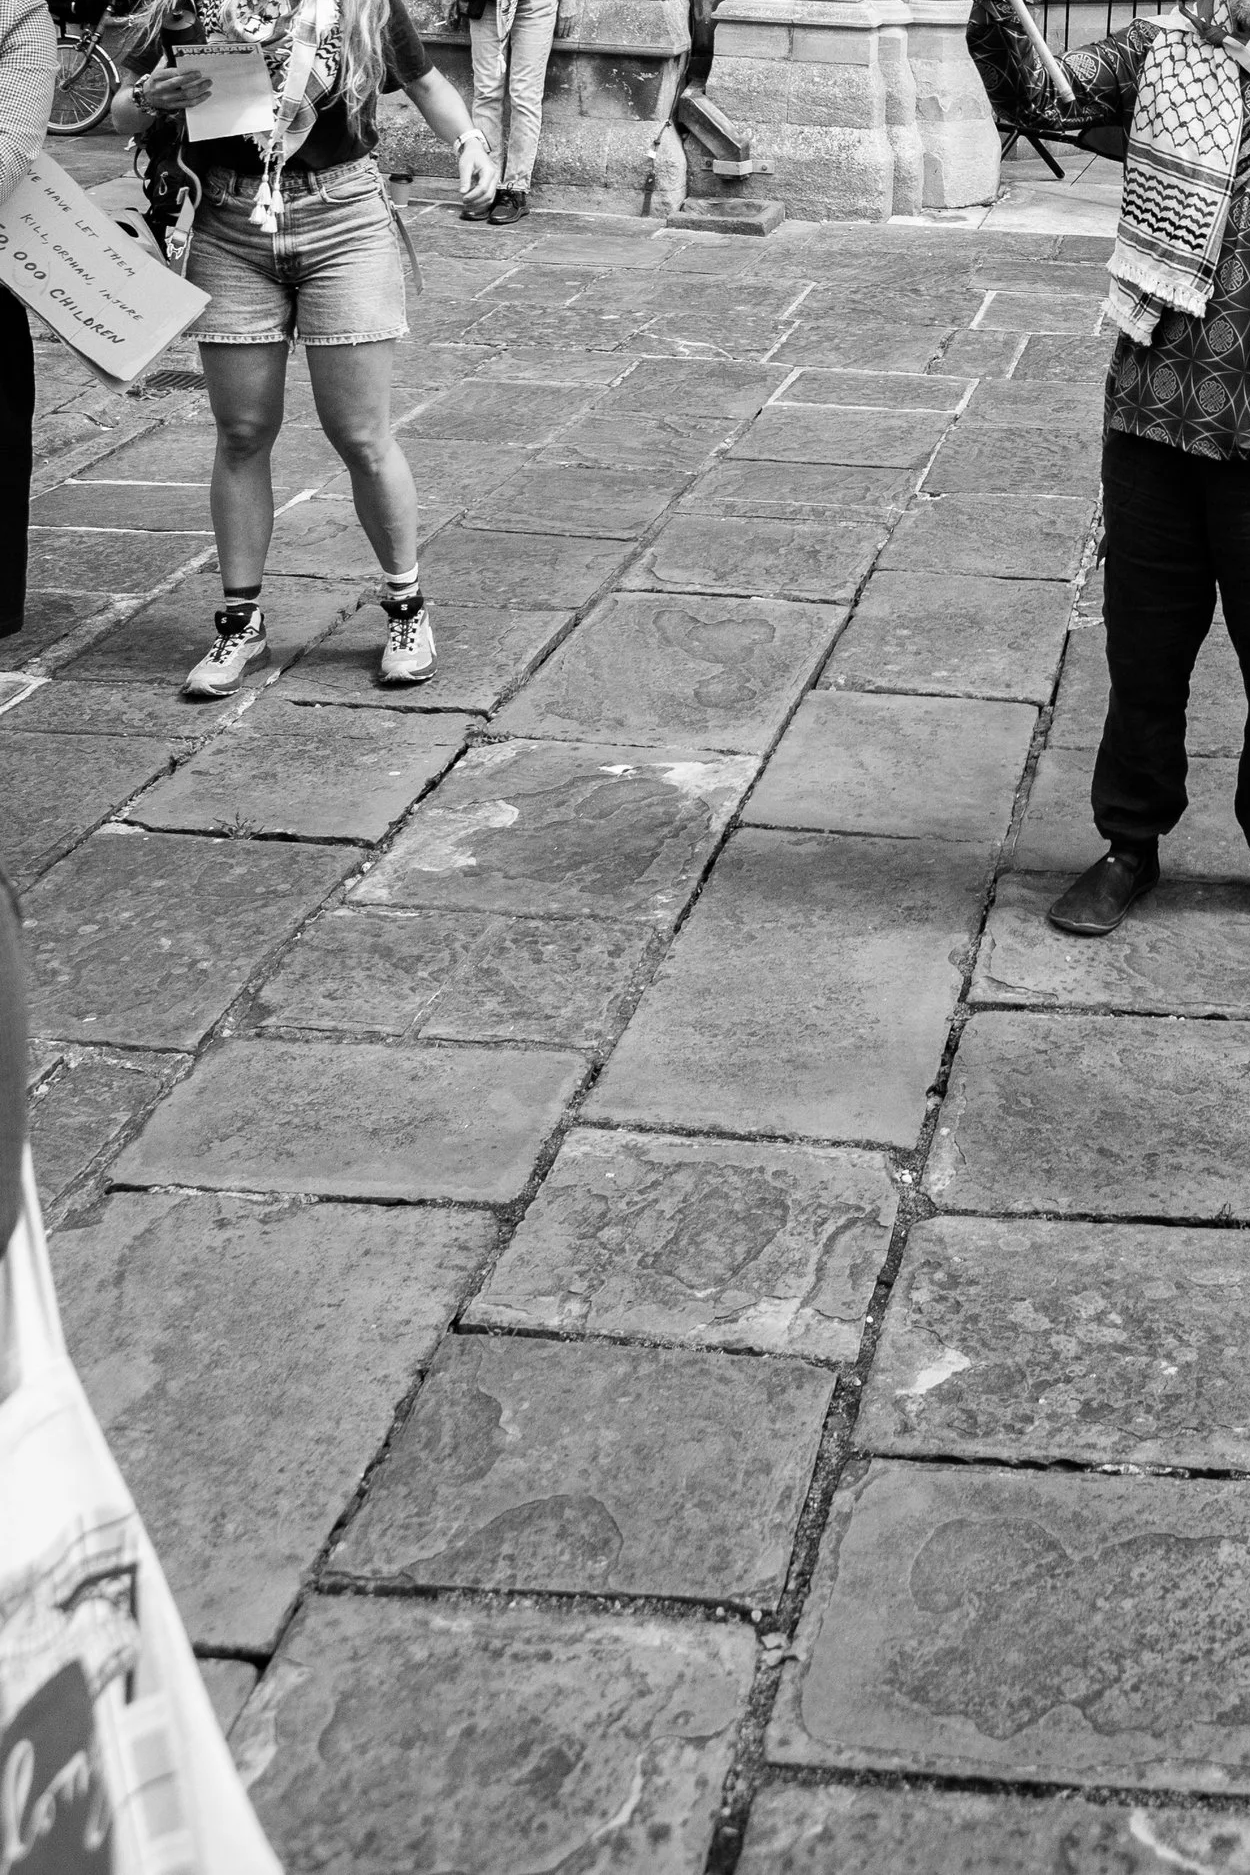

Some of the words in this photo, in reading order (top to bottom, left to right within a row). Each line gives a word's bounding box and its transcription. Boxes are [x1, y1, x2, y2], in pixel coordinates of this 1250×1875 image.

[20, 214, 48, 244] KILL,
[53, 245, 95, 286] ORPHAN,
[100, 289, 143, 321] INJURE
[44, 187, 72, 213] HAVE
[75, 220, 99, 239] LET
[103, 246, 136, 277] THEM
[50, 288, 125, 344] CHILDREN
